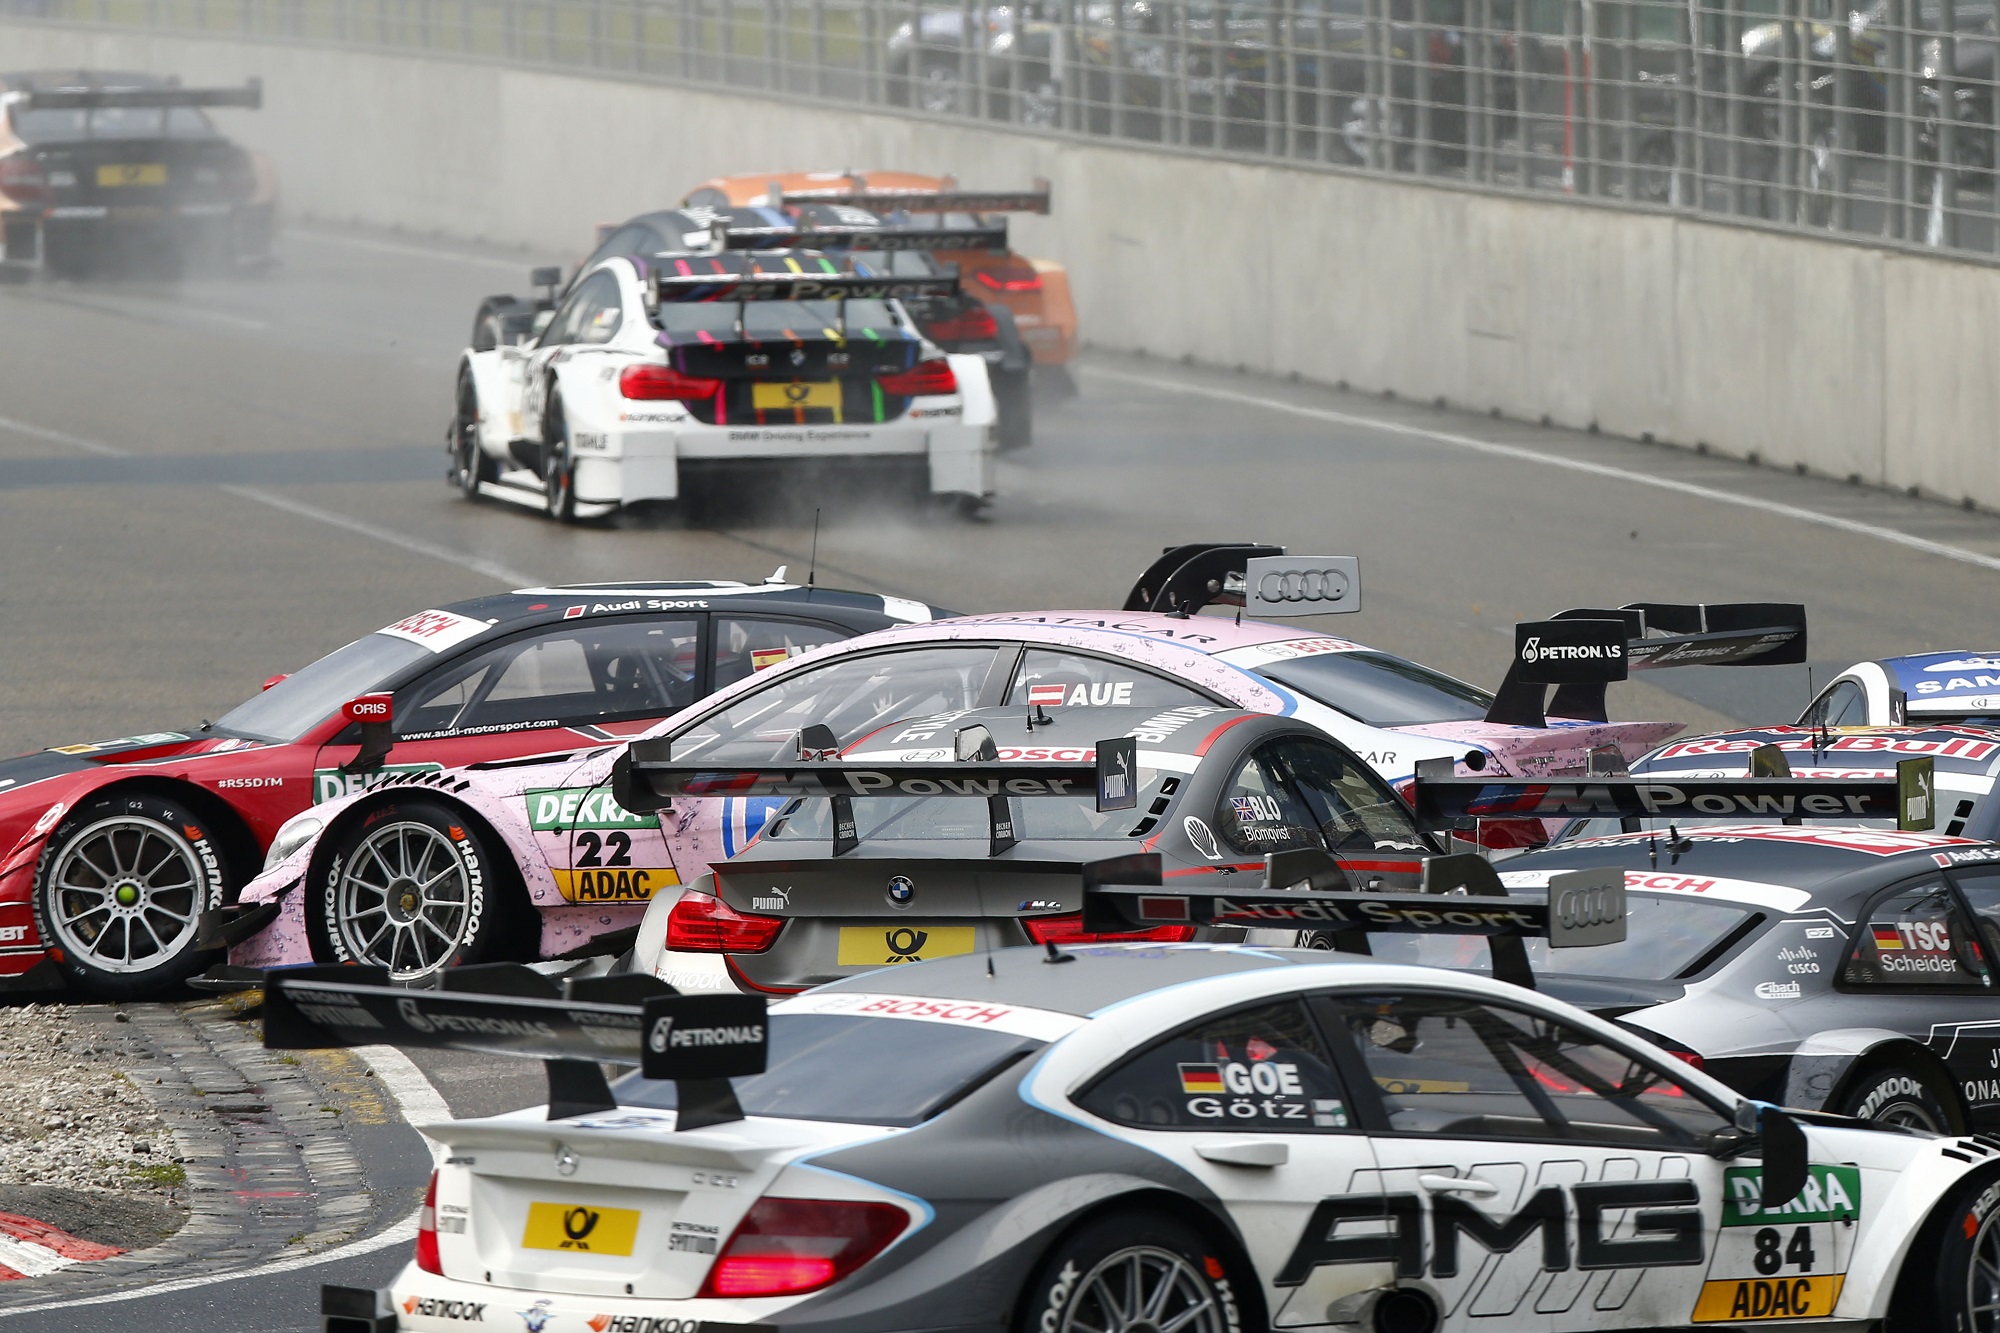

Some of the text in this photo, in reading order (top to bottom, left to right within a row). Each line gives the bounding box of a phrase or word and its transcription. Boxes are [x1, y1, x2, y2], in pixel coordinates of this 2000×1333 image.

[791, 281, 943, 299] Power
[763, 431, 803, 442] Driving
[807, 431, 871, 441] Experience
[592, 598, 709, 613] Audi Sport
[1067, 682, 1133, 706] AUE
[352, 703, 387, 715] ORIS
[401, 717, 559, 742] www.audi-motorsport.com
[1657, 737, 1997, 760] Red Bull
[846, 771, 1073, 797] Power
[1250, 795, 1281, 821] BLO
[1635, 785, 1873, 814] Power
[1244, 826, 1290, 843] Blomqvist
[576, 831, 632, 867] 22
[1948, 850, 1987, 862] Audi
[579, 870, 650, 900] ADAC
[753, 897, 784, 909] PUMA
[1031, 900, 1062, 911] M4
[1213, 899, 1543, 928] Audi Sport
[1897, 922, 1950, 951] TSC
[1883, 954, 1957, 973] Scheider
[1755, 981, 1800, 998] Eibach
[859, 1001, 1010, 1024] BOSCH
[429, 1014, 557, 1038] PETRONAS
[670, 1026, 764, 1047] PETRONAS
[1226, 1062, 1303, 1095] GOE
[1187, 1098, 1307, 1119] Götz
[671, 1222, 719, 1234] PETRONAS
[1274, 1178, 1705, 1287] AMG
[1754, 1226, 1815, 1275] 84
[1731, 1279, 1811, 1317] ADAC
[415, 1298, 487, 1322] Hankook
